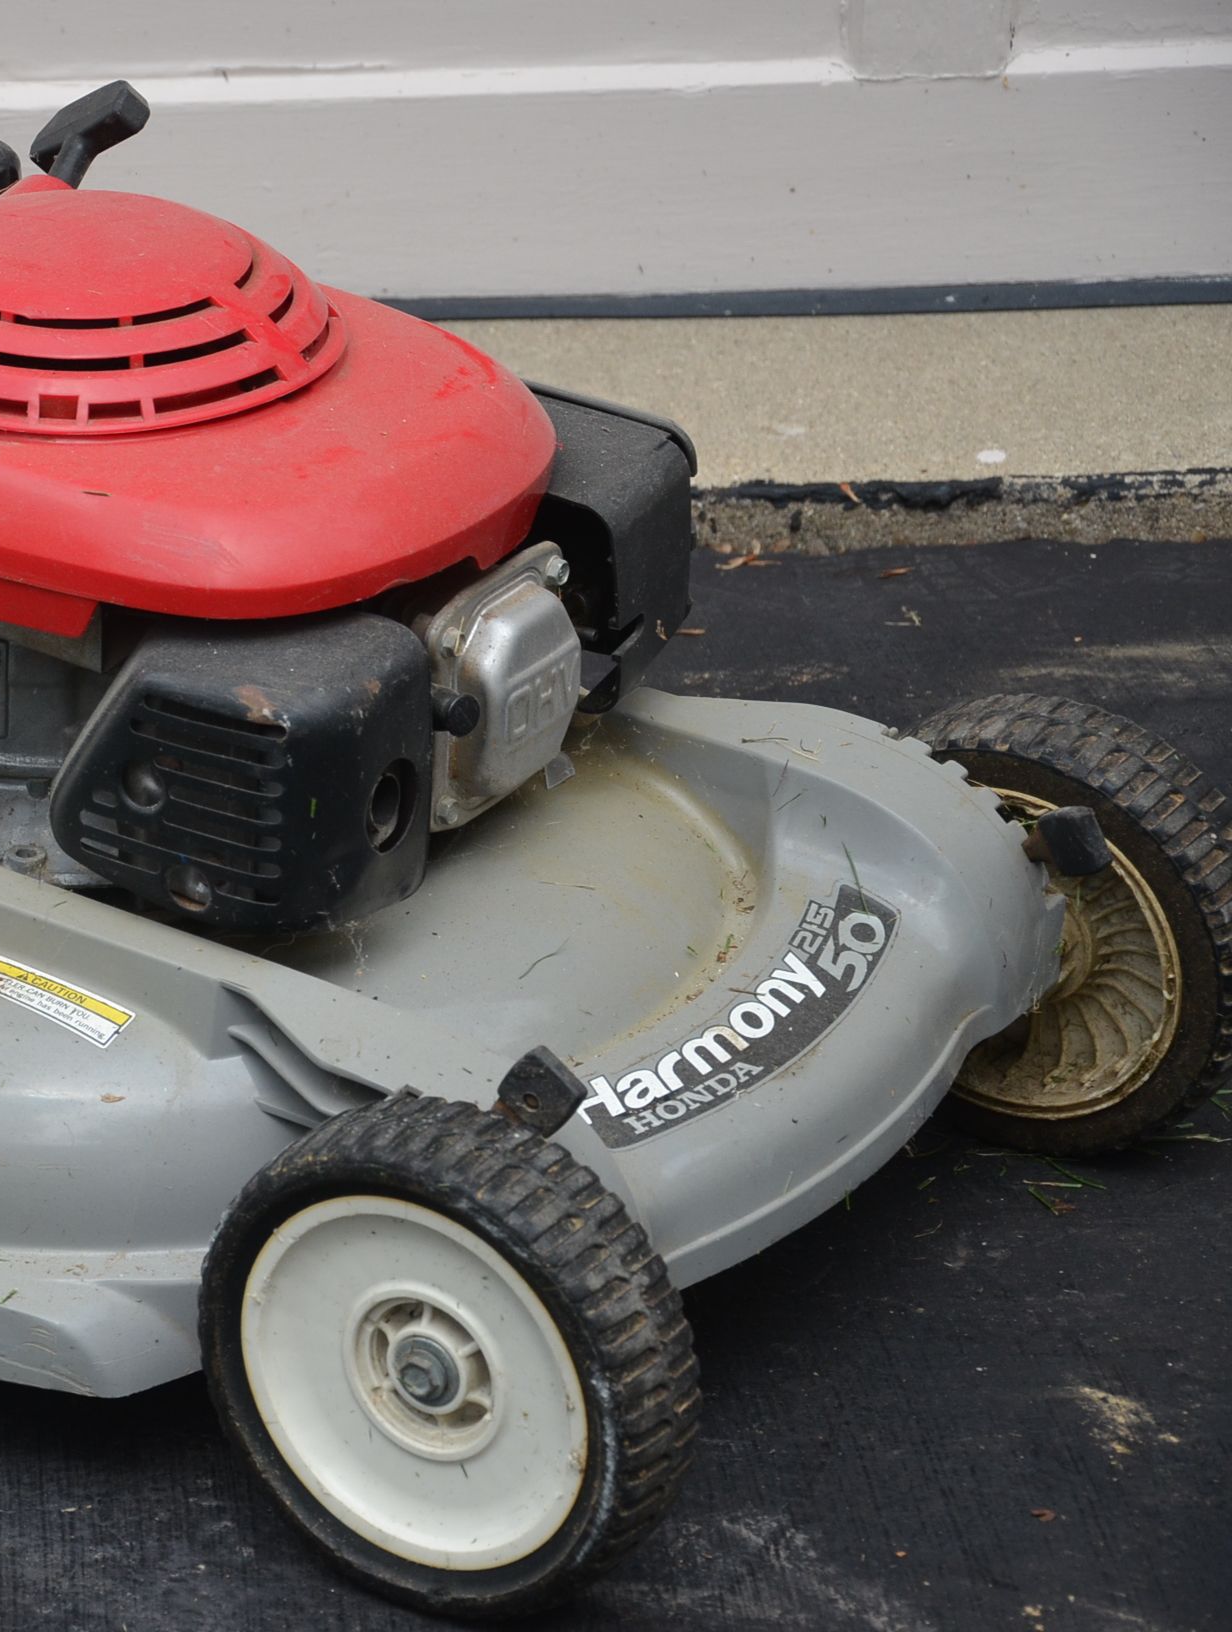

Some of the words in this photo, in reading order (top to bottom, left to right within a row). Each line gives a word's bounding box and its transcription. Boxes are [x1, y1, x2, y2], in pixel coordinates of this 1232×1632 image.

[8, 988, 36, 1005] engine
[37, 999, 53, 1012] has
[53, 1007, 74, 1022] been
[26, 986, 45, 1000] CAN
[45, 993, 69, 1010] BURN
[31, 975, 89, 1005] CAUTION
[576, 951, 827, 1125] Harmony
[621, 1061, 765, 1136] HONDA
